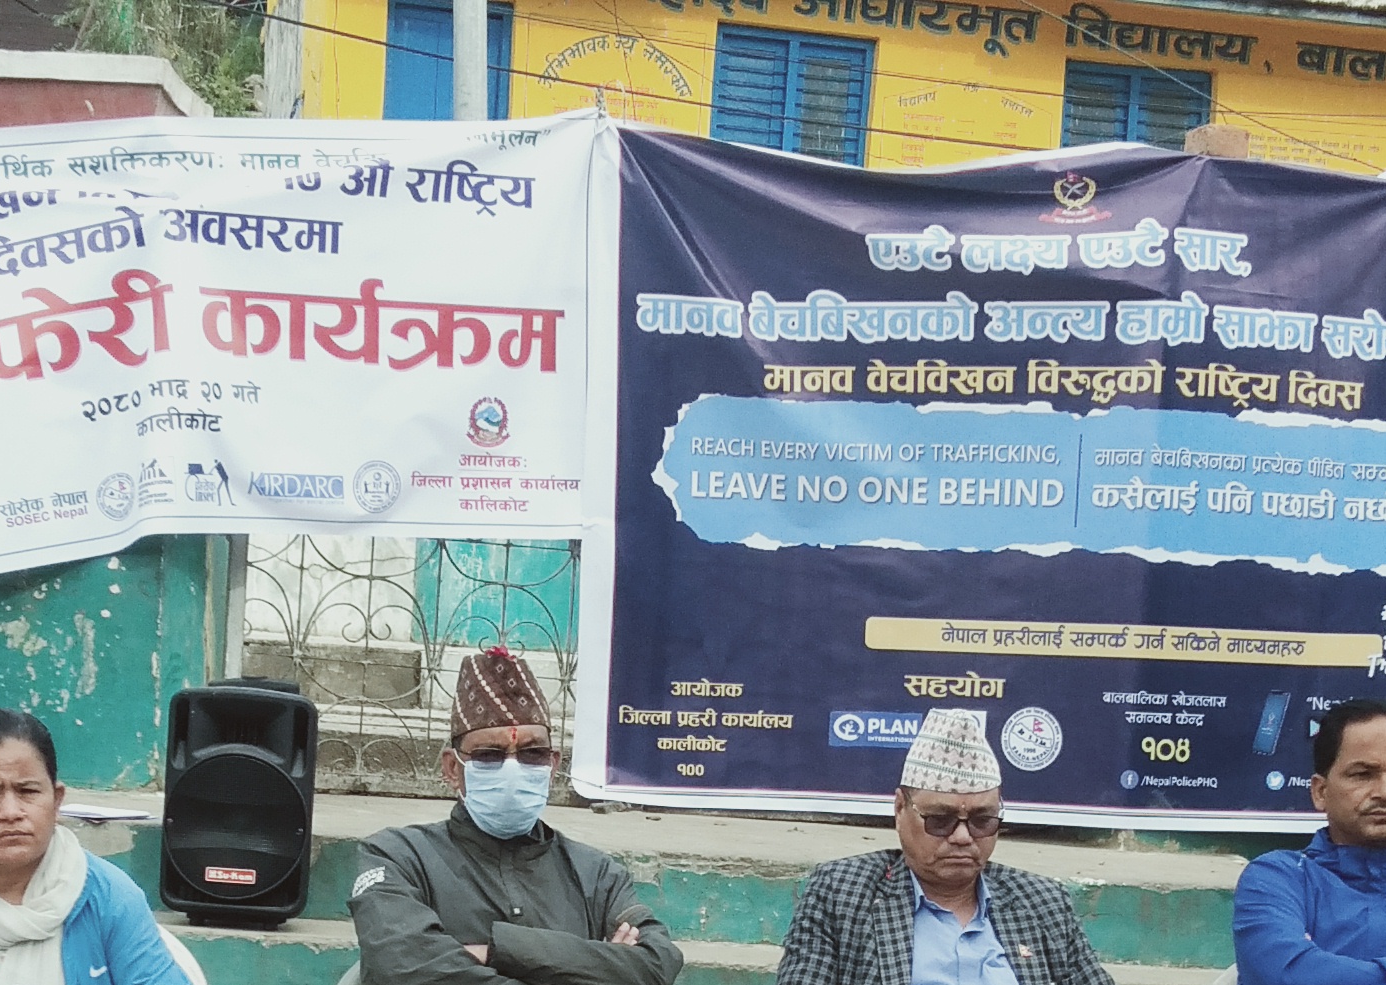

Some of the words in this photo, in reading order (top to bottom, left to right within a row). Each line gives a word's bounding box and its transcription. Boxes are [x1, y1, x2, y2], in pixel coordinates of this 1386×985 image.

[237, 153, 302, 171] मानव
[405, 159, 536, 217] राष्ट्रिय
[866, 224, 956, 272] एउटै
[960, 233, 1072, 276] लक्ष्य
[1077, 218, 1169, 269] एउटै
[1173, 226, 1252, 278] सार,
[198, 278, 565, 374] कार्यक्रम
[635, 292, 744, 339] मानव
[747, 288, 979, 344] बेचबिखनको
[984, 300, 1111, 343] अन्त्य
[1116, 290, 1210, 346] हाम्रो
[1213, 304, 1318, 353] साझा
[763, 363, 856, 395] मानव
[1174, 361, 1282, 408] राष्ट्रिय
[1287, 369, 1364, 411] दिवस
[81, 390, 142, 422] २०८०
[148, 379, 191, 400] भाद्र
[200, 381, 223, 403] २०
[231, 381, 262, 404] गते
[136, 406, 223, 437] कालीकोट
[690, 437, 755, 458] REACH
[760, 440, 820, 461] EVERY
[824, 442, 893, 462] VICTIM
[897, 444, 925, 463] OF
[930, 443, 1062, 466] TRAFFICKING,
[1094, 448, 1145, 468] मानव
[1251, 452, 1304, 477] प्रत्येक
[1307, 455, 1346, 480] पीडित
[248, 471, 344, 499] KIRDARC
[410, 471, 454, 489] जिल्ला
[459, 477, 513, 491] प्रशासन
[518, 475, 581, 491] कार्यालय
[690, 470, 787, 501] LEAVE
[796, 475, 849, 503] NO
[857, 475, 929, 504] ONE
[937, 477, 1065, 508] BEHIND
[51, 490, 89, 509] नेपाल
[458, 495, 530, 512] कालिकोट
[1091, 475, 1201, 517] कसैलाई
[1206, 480, 1255, 515] पनि
[6, 512, 51, 528] SOSEC
[54, 505, 89, 521] Nepal
[940, 622, 989, 644] नेपाल
[992, 624, 1065, 650] प्रहरीलाई
[1069, 626, 1130, 648] सम्पर्क
[1134, 627, 1165, 651] गर्न
[1170, 629, 1221, 653] सकिने
[670, 677, 745, 699] आयोजक
[903, 670, 1007, 699] सहयोग
[1102, 691, 1169, 706] बालबालिका
[618, 703, 672, 727] जिल्ला
[676, 707, 718, 728] प्रहरी
[721, 709, 794, 730] कार्यालय
[867, 717, 918, 736] PLAN
[1124, 711, 1173, 725] समन्वय
[1175, 709, 1206, 727] केन्द्र
[657, 734, 728, 752] कालीकोट
[1141, 736, 1191, 763] १०४
[676, 762, 705, 777] १००
[1140, 775, 1218, 789] /NepalPolicePHQ
